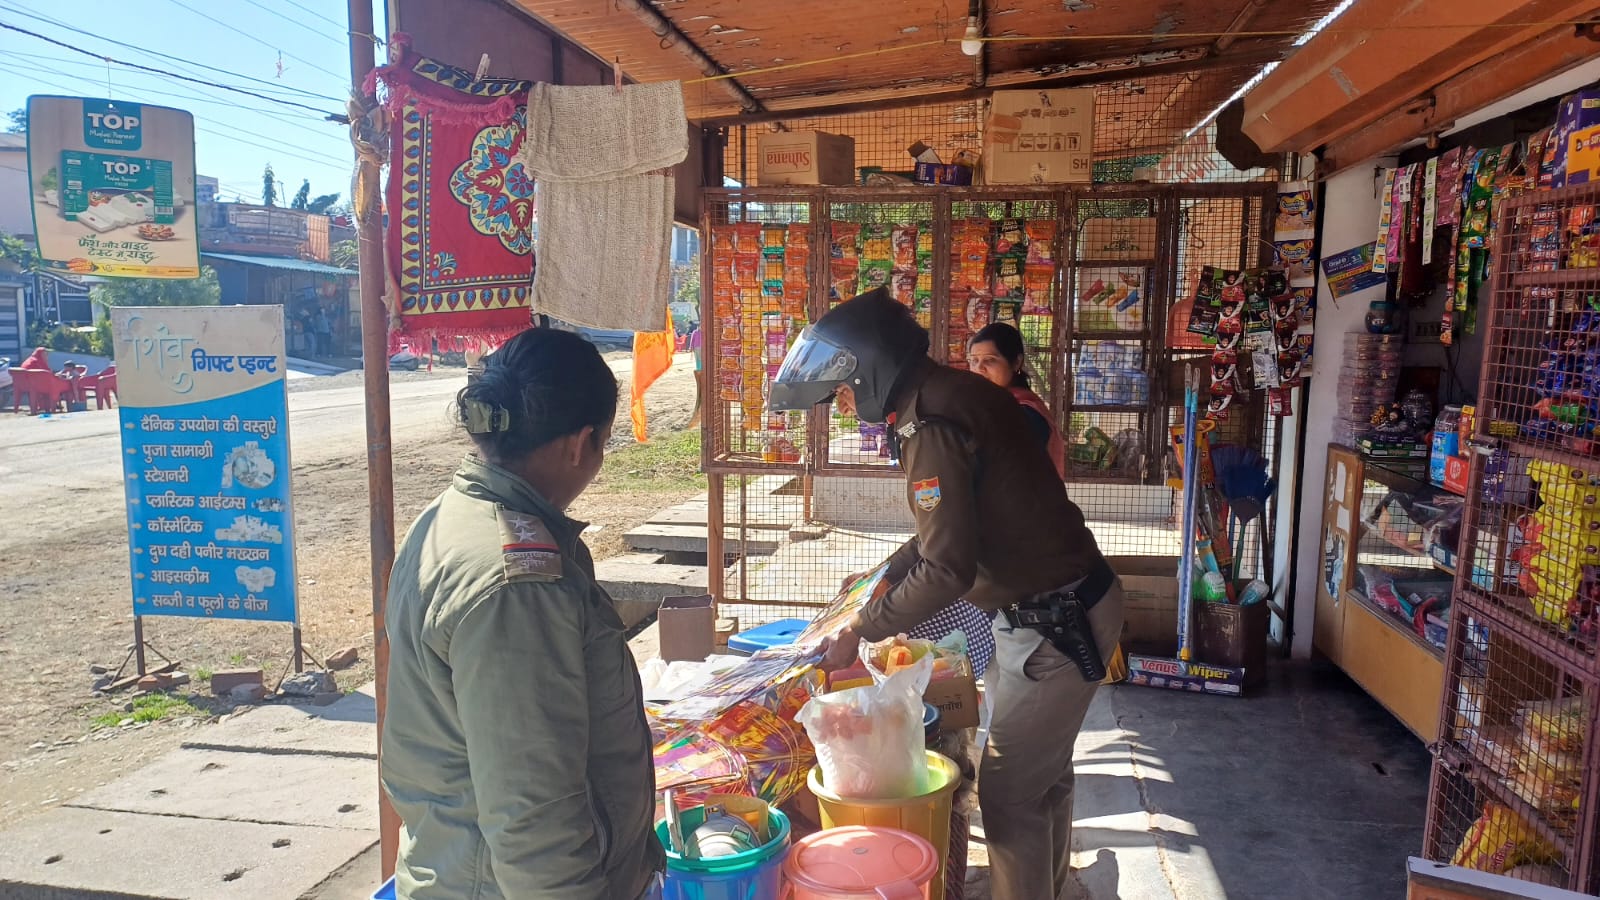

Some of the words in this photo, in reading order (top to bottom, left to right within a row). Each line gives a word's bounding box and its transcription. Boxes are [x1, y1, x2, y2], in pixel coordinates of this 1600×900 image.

[87, 112, 140, 131] TOP
[766, 146, 810, 167] Suhana
[1072, 158, 1088, 169] SH
[102, 160, 141, 175] TOP
[190, 347, 235, 373] गिफ्ट
[141, 414, 175, 431] दैनिक
[178, 415, 219, 432] उपयोग
[222, 415, 240, 432] की
[144, 465, 189, 482] स्टेशनरी
[145, 490, 195, 508] प्लास्टिक
[147, 516, 204, 533] कॉस्मेटिक
[170, 540, 191, 559] दही
[194, 541, 224, 559] पनीर
[152, 590, 182, 607] सब्जी
[186, 595, 195, 608] व
[227, 594, 240, 610] के
[243, 594, 268, 611] बीज
[1139, 659, 1178, 676] Venus
[1188, 664, 1231, 681] Wiper
